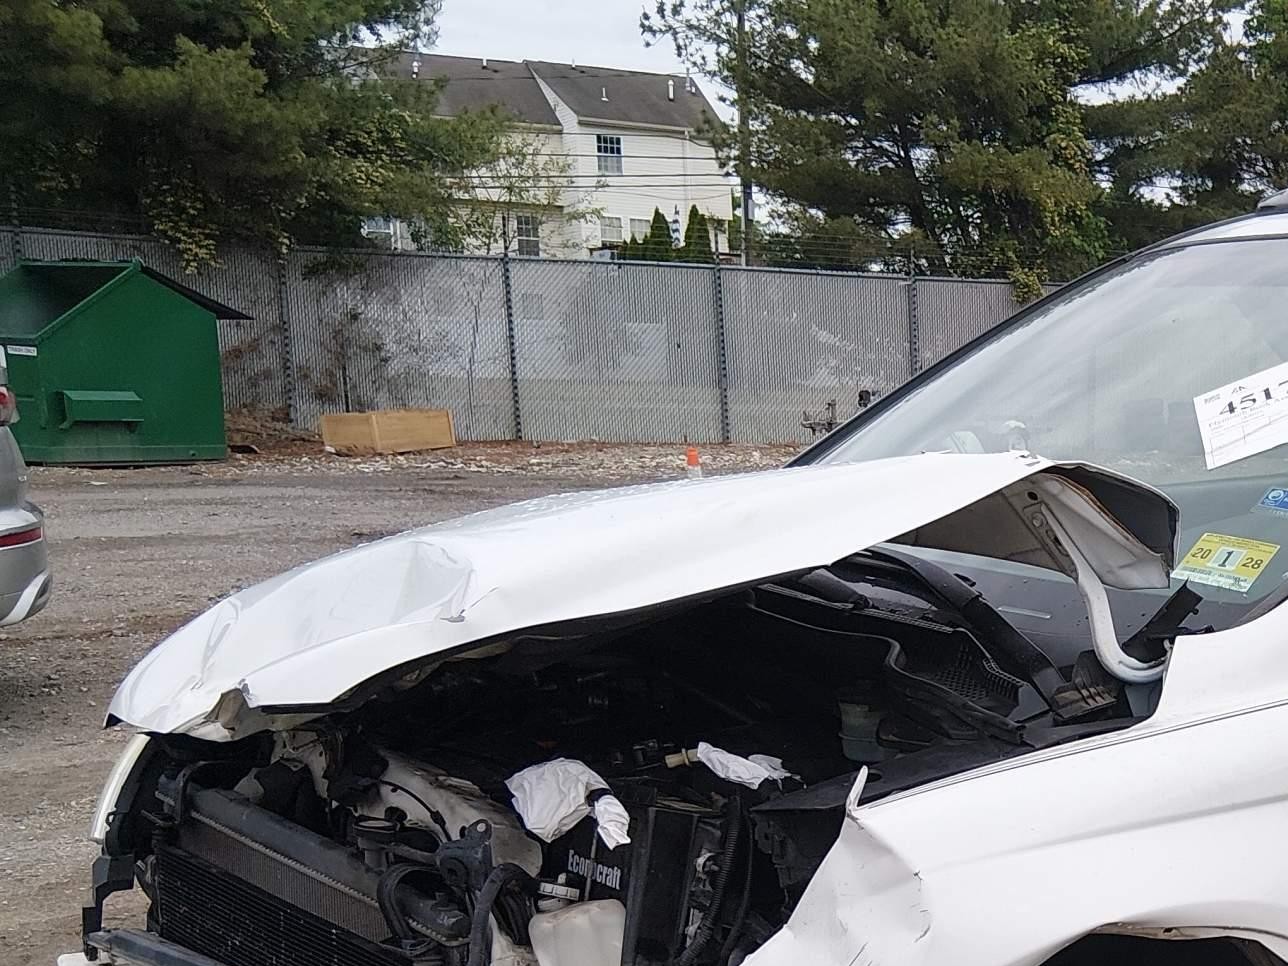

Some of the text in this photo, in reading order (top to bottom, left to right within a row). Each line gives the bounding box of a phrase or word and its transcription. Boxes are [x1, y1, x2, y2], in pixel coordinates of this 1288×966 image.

[1191, 547, 1264, 570] 20 1 28
